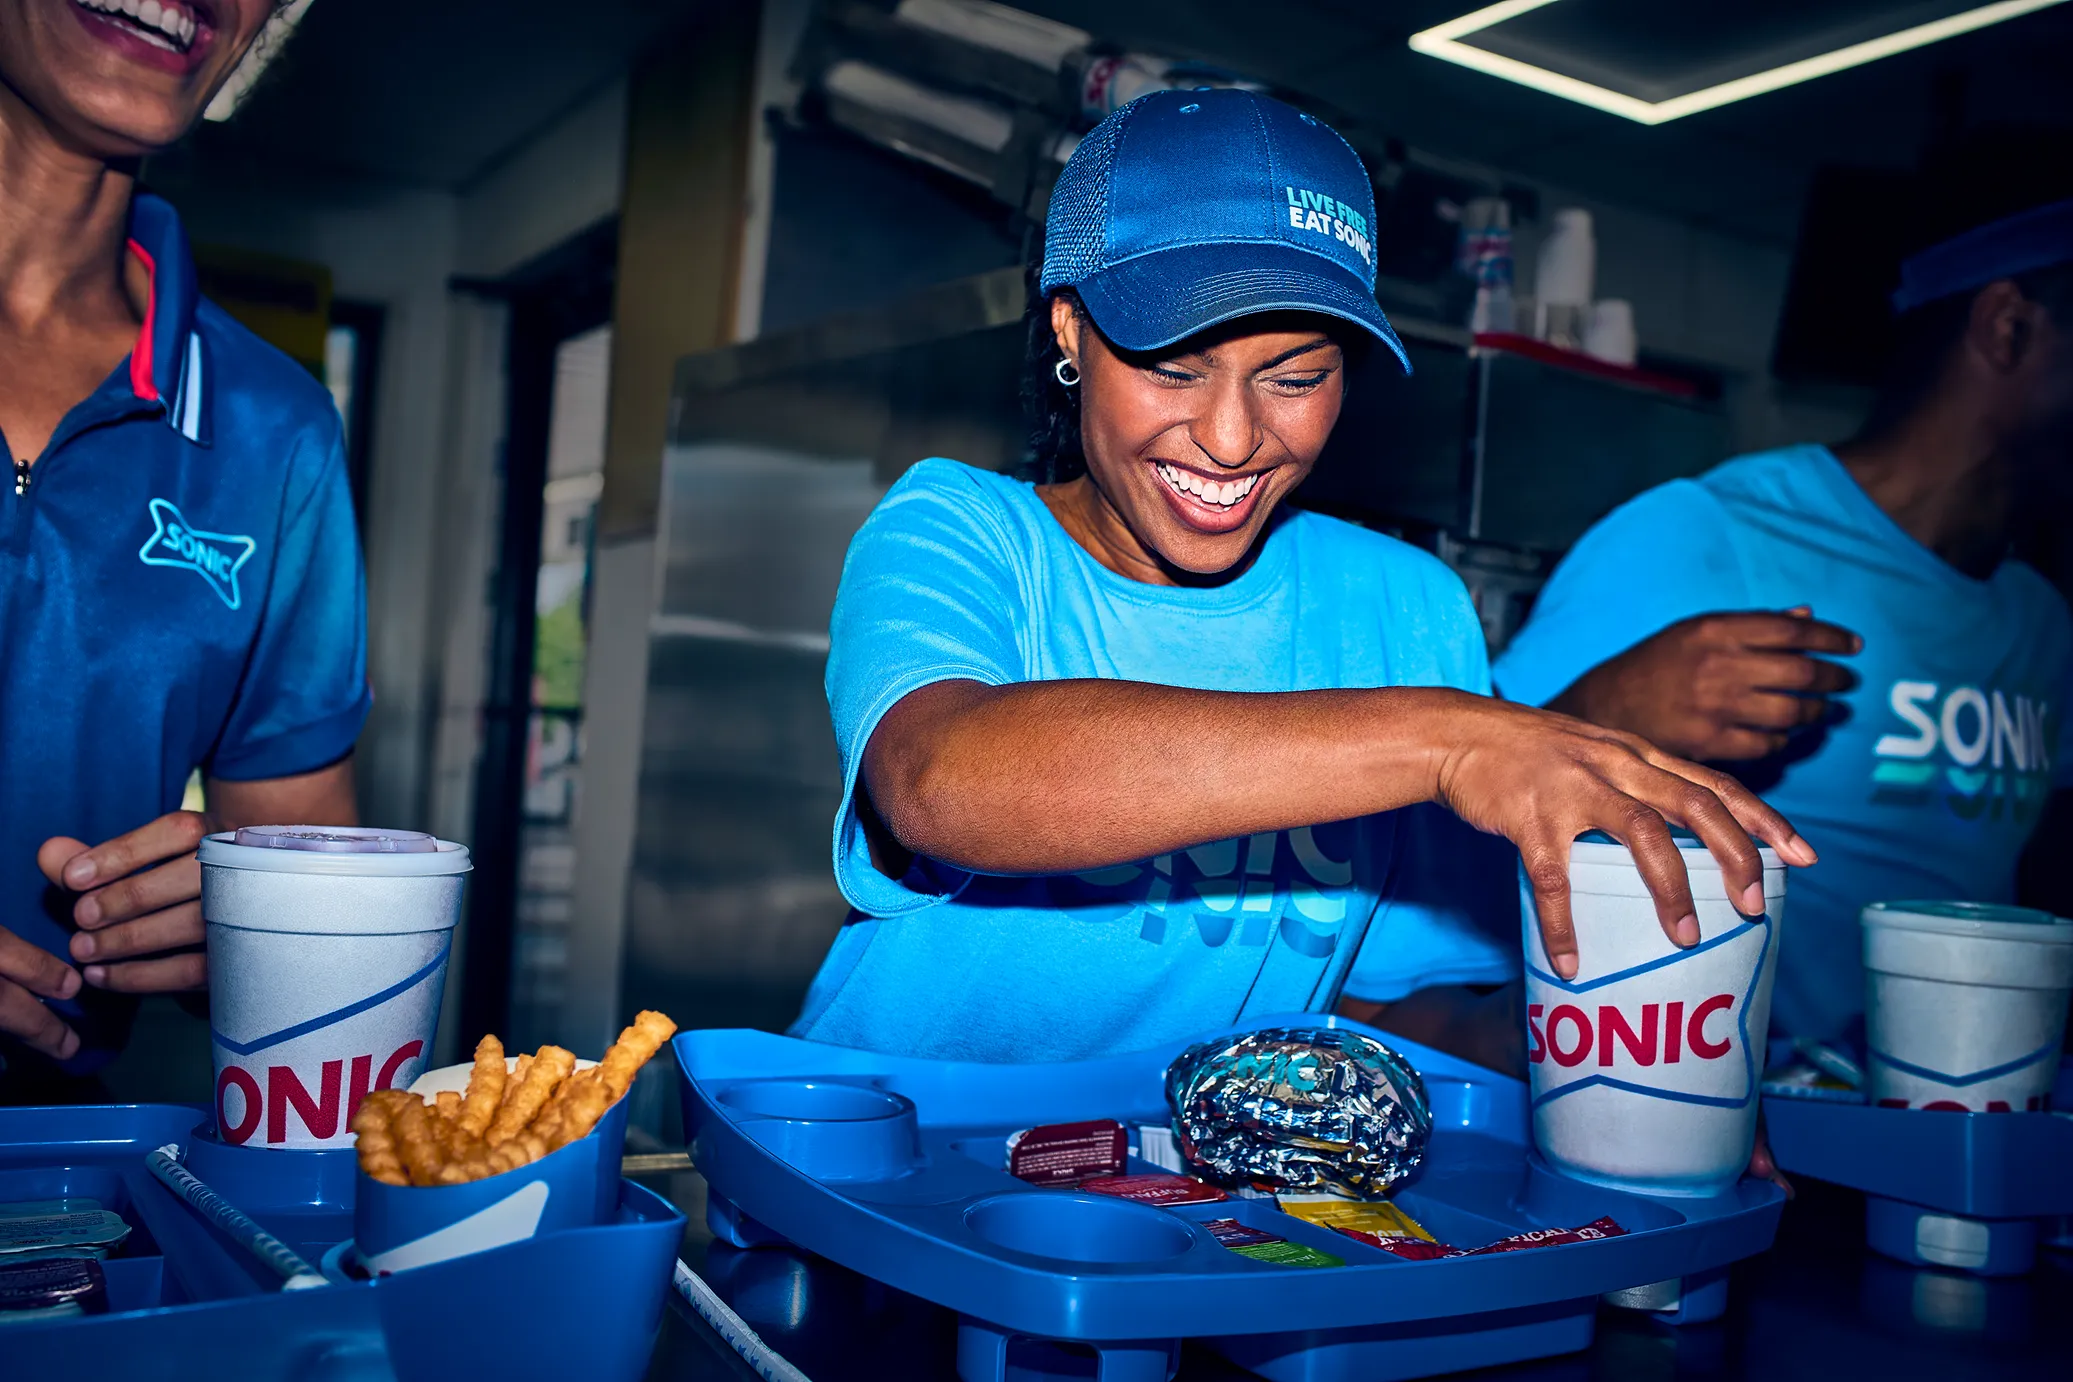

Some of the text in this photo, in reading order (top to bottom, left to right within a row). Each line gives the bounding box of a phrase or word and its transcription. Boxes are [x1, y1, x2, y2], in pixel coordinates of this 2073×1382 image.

[1286, 186, 1369, 240] LIVE FREE
[1289, 206, 1372, 265] EAT SONIC
[161, 522, 233, 583] SONIC
[1528, 994, 1735, 1067] SONIC
